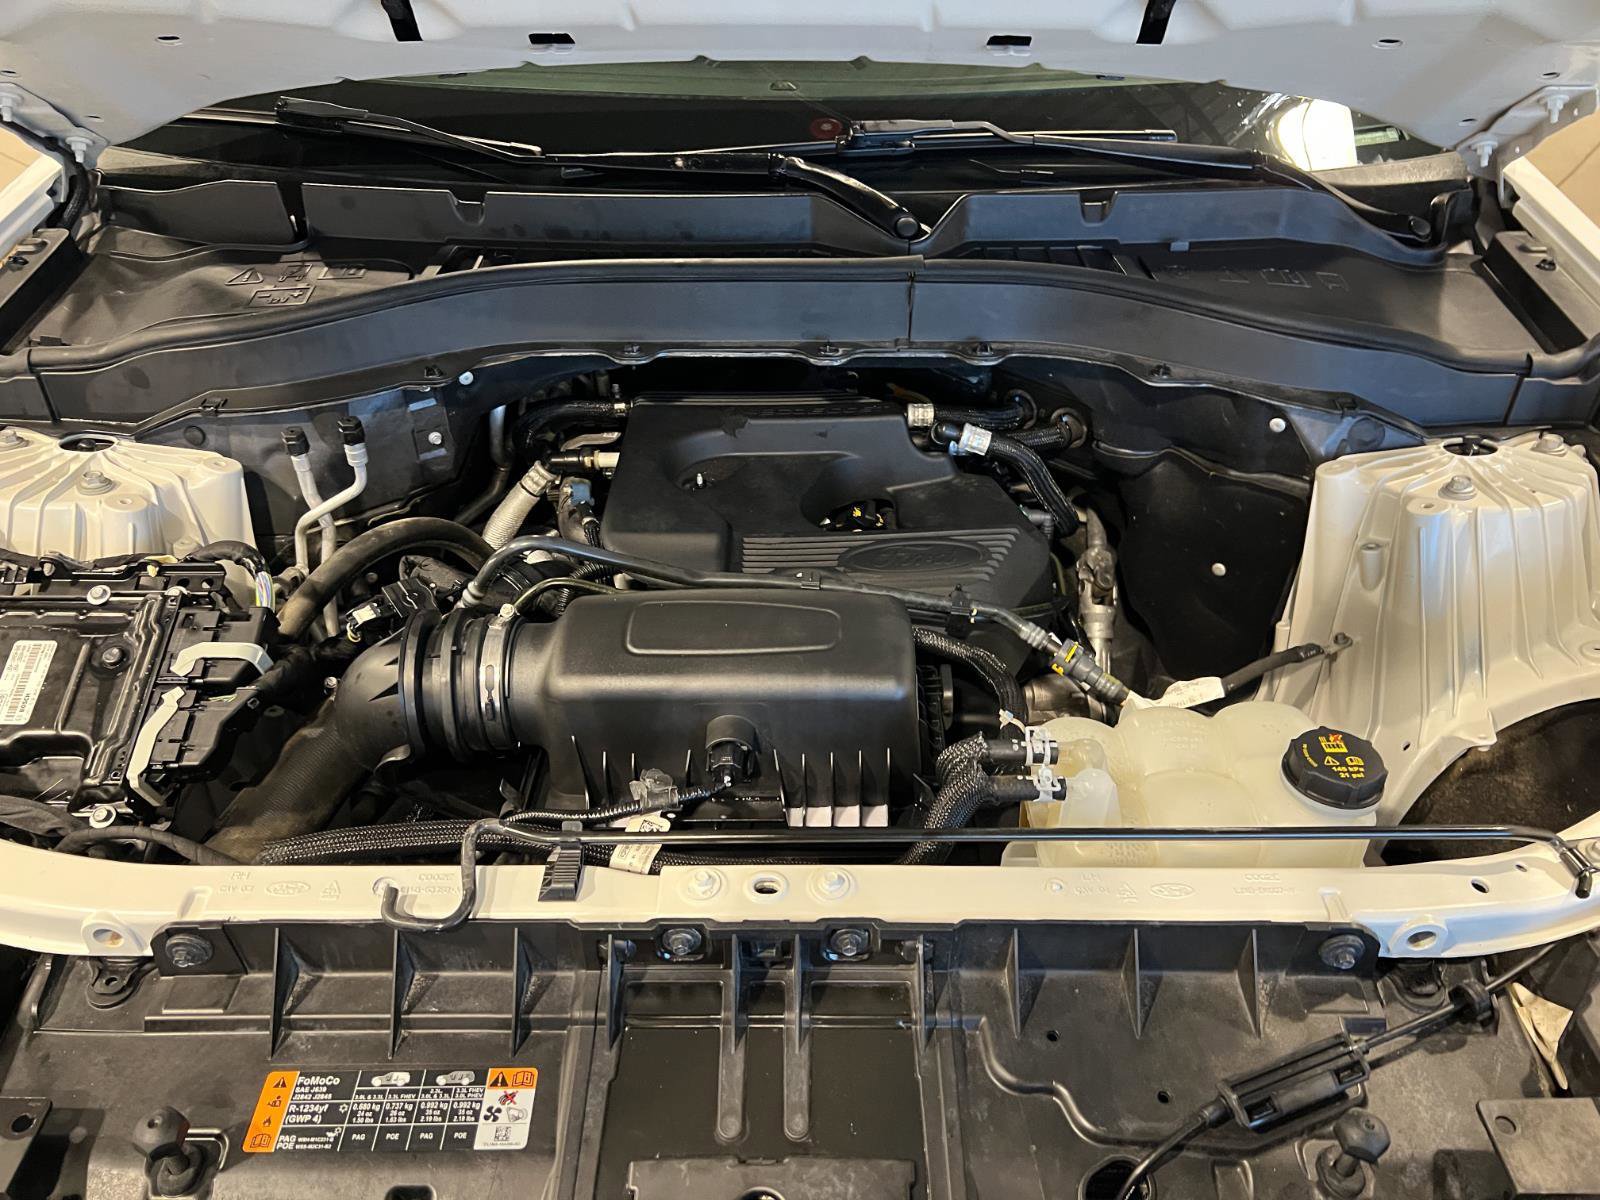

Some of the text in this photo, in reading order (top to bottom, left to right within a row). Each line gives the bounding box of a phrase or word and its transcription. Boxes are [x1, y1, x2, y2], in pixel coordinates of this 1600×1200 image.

[297, 1075, 341, 1087] FoMoCo
[288, 1103, 330, 1114] R-1234yf
[352, 1102, 381, 1112] 0.680 kg
[385, 1102, 414, 1111] 0.737 kg
[420, 1101, 449, 1111] 0.992 kg
[453, 1101, 481, 1110] 0.992 kg
[285, 1114, 323, 1125] (GWP 4)
[279, 1134, 297, 1142] PAG
[352, 1133, 366, 1141] PAG
[385, 1132, 400, 1140] POE
[420, 1132, 434, 1140] PAG
[453, 1131, 468, 1139] POE
[276, 1142, 296, 1150] POE
